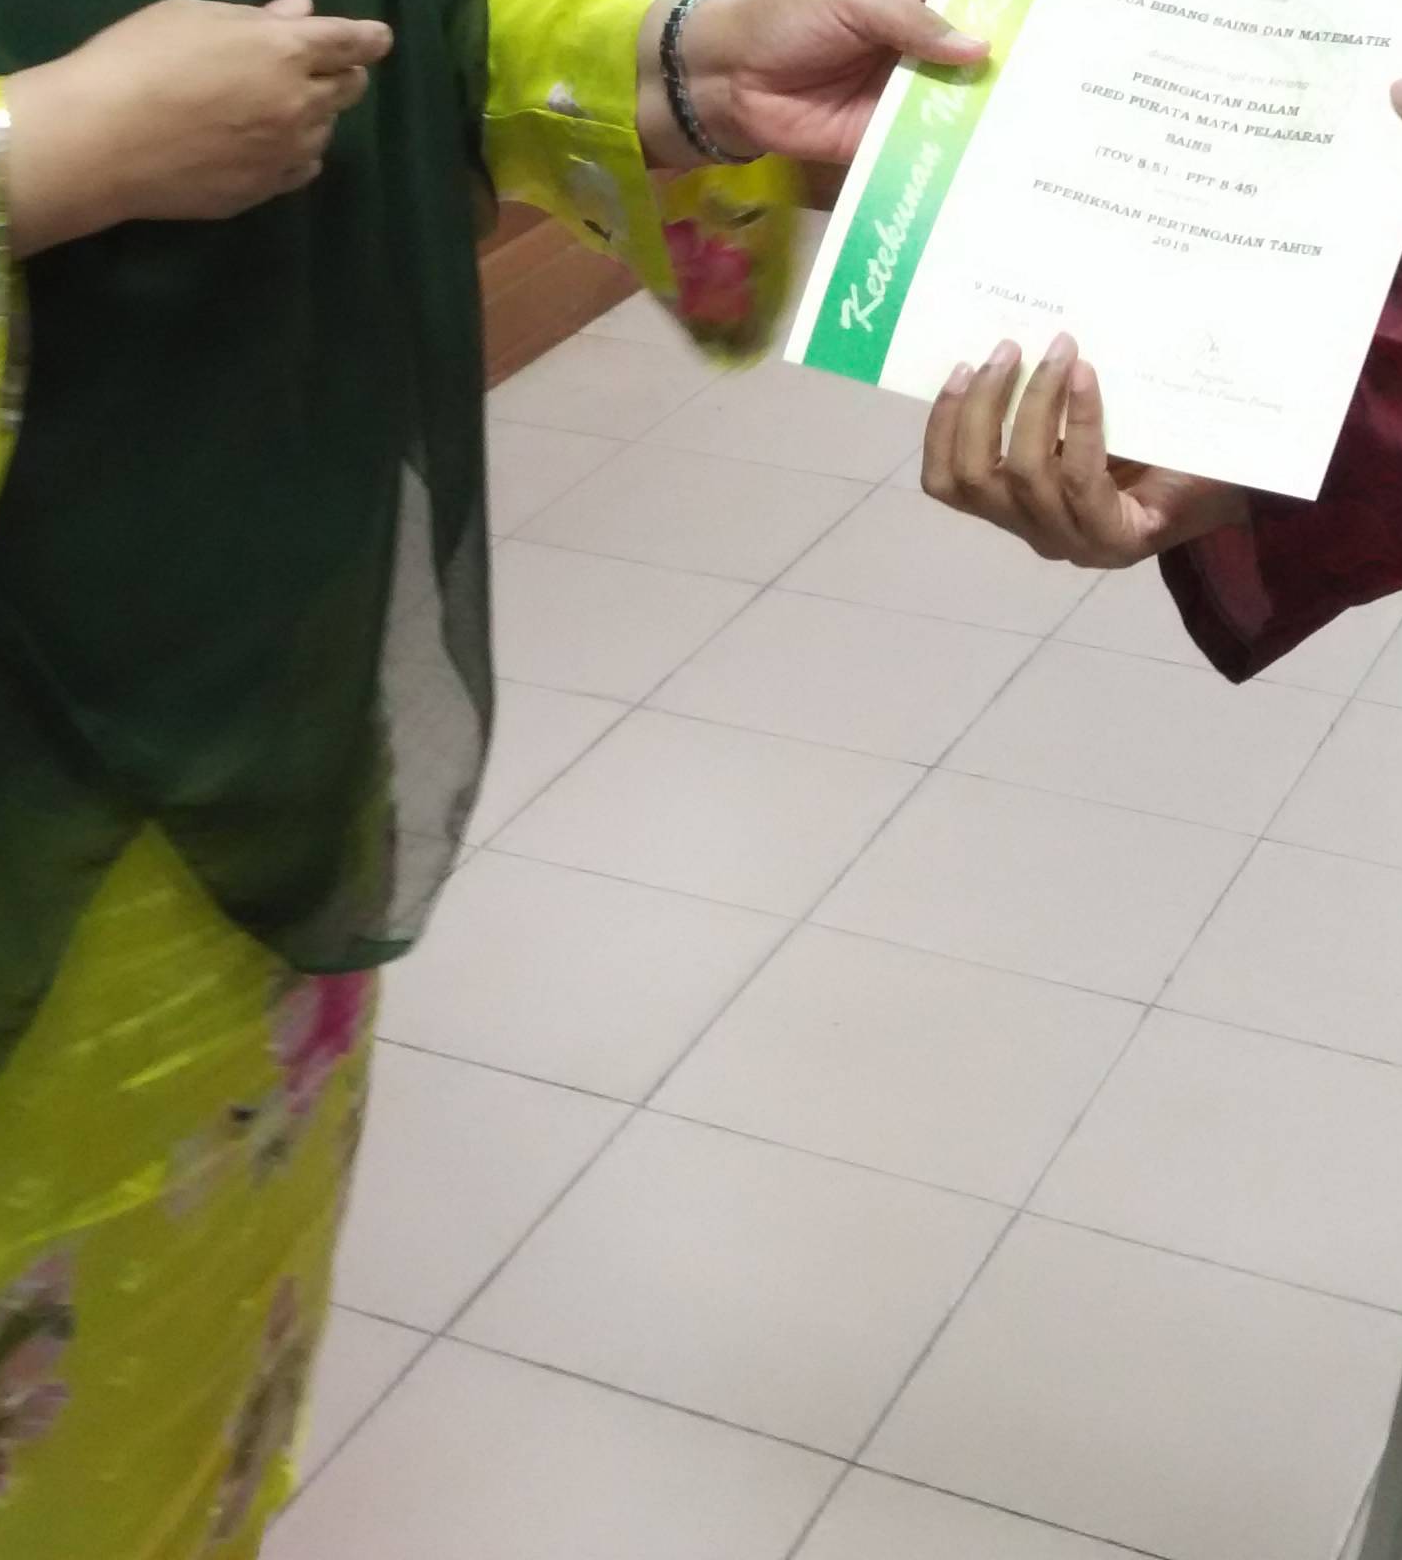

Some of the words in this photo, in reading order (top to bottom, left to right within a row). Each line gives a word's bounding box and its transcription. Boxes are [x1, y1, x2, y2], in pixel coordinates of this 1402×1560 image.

[1150, 0, 1210, 23] BIDANG
[1213, 16, 1259, 34] SAINS
[1262, 25, 1294, 38] DAN
[1298, 29, 1393, 48] MATEMATIK
[1081, 81, 1125, 102] GRED
[1128, 94, 1191, 122] PURATA
[1195, 114, 1239, 134] MATA
[1245, 124, 1335, 145] PELAJARAN
[1132, 70, 1243, 109] PENINGKATAN
[1246, 100, 1301, 118] DALAM
[1094, 144, 1135, 164] (TOV
[1185, 170, 1216, 188] PPT
[1165, 132, 1213, 153] SAINS
[1033, 179, 1142, 220] PEPERIKSAAN
[1146, 212, 1266, 249] PERTENGAHAN
[1269, 239, 1324, 257] TAHUN
